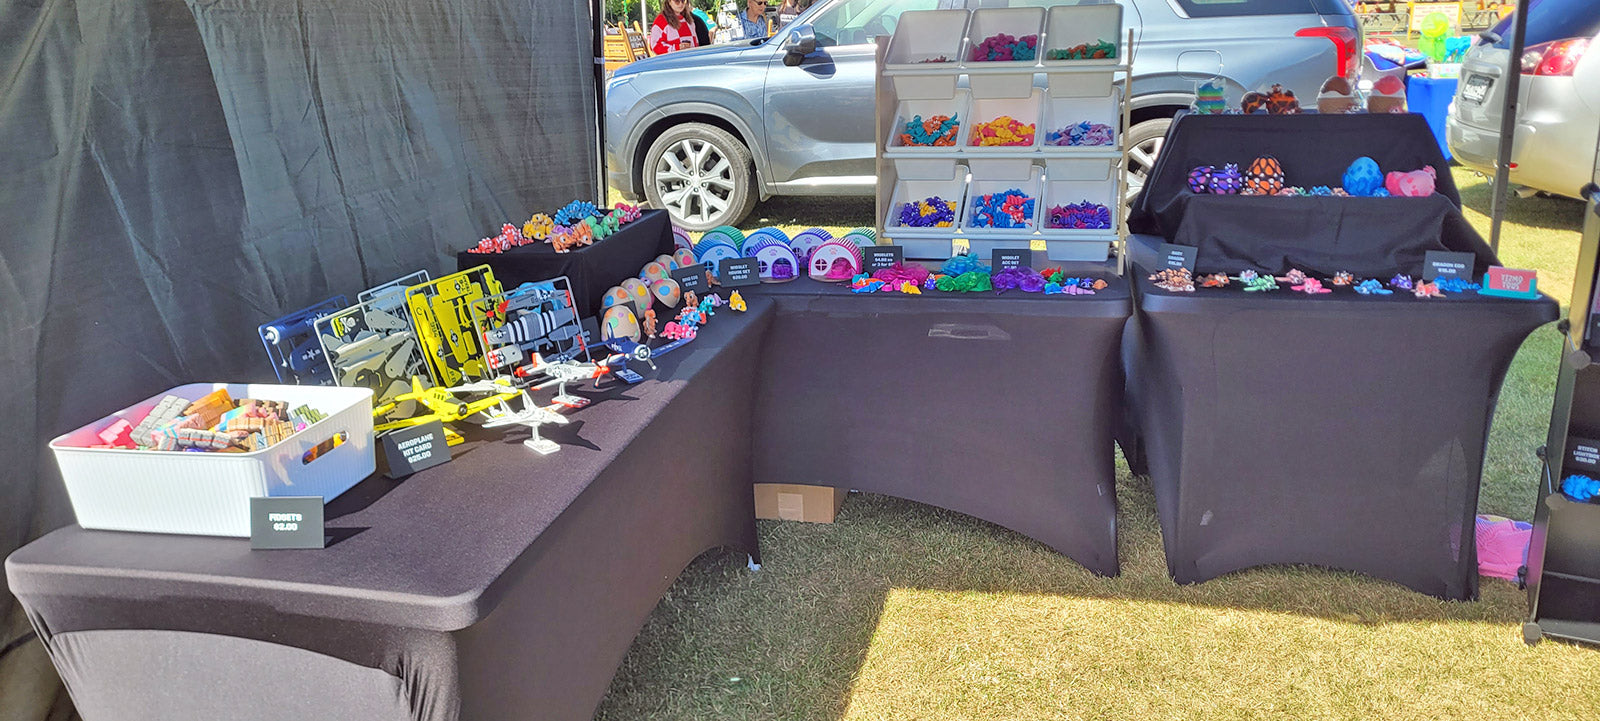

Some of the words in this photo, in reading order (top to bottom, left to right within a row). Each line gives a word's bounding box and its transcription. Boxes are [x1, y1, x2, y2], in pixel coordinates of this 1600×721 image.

[397, 432, 434, 451] AEROPLANE
[402, 448, 414, 457] KIT
[414, 442, 433, 453] CARD
[268, 513, 303, 521] FIDGETS
[273, 522, 299, 531] $2.00
